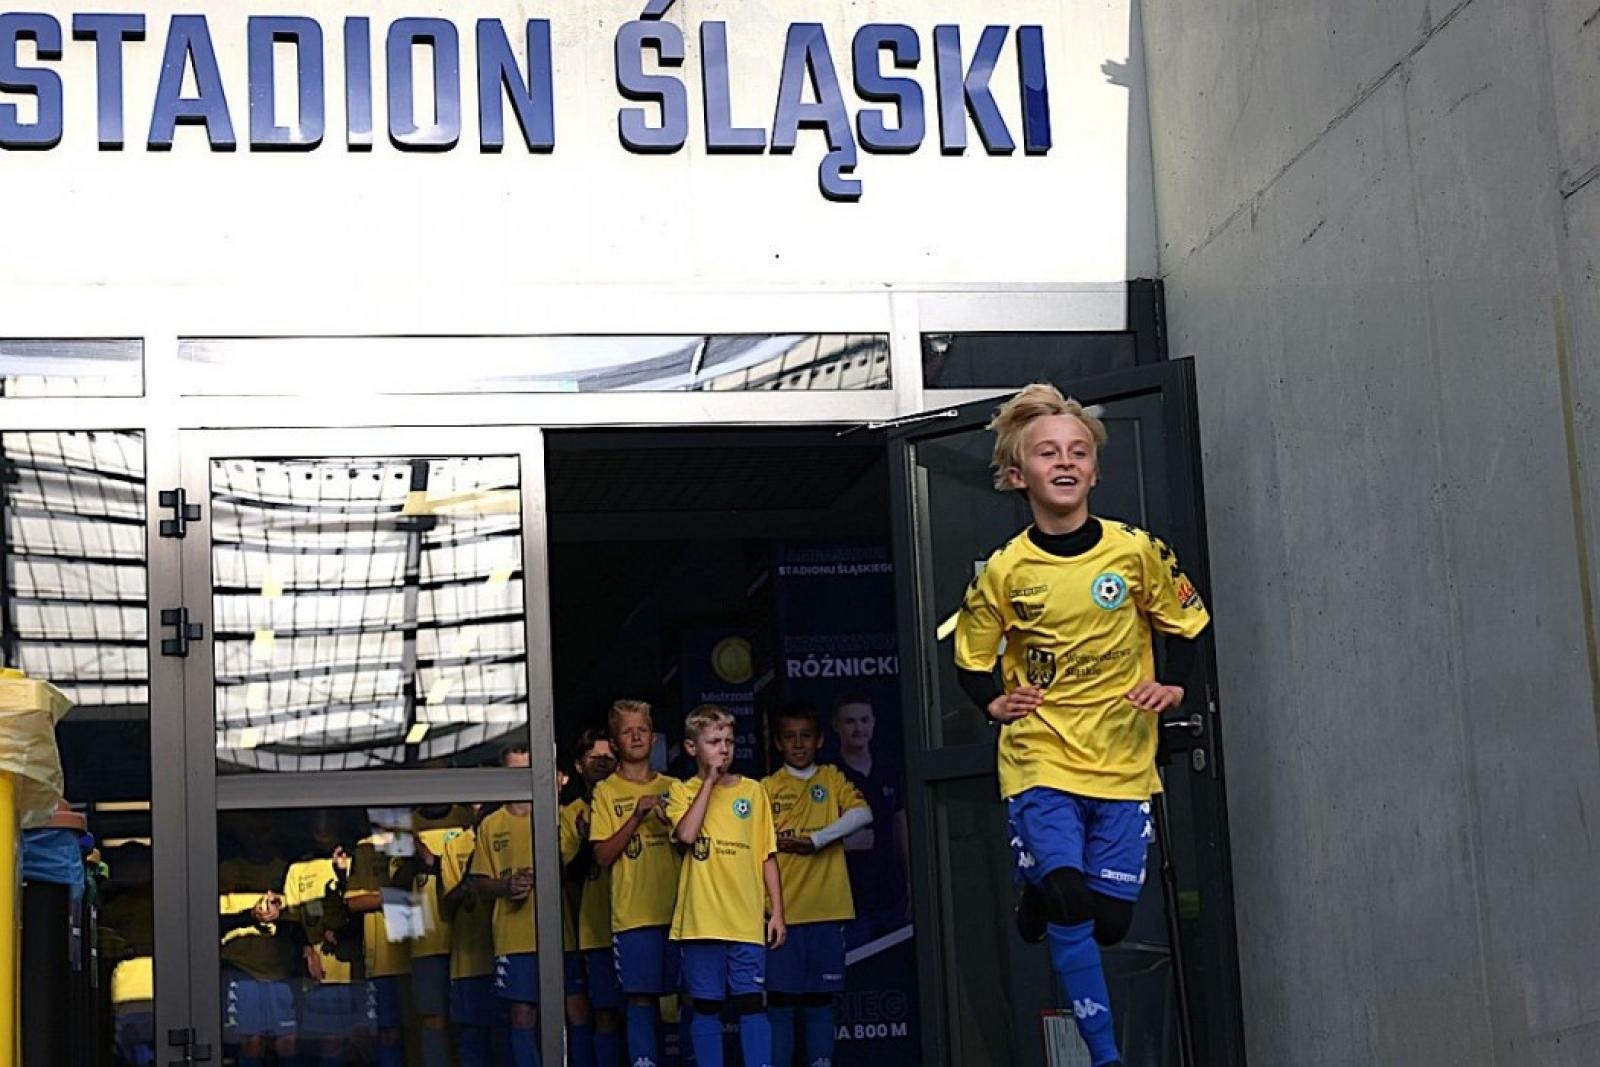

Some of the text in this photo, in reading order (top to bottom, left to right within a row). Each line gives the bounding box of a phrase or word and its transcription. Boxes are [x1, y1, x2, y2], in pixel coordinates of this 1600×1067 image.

[0, 0, 1052, 203] STADION ŚLĄSKI
[778, 565, 836, 576] STADIONU
[854, 1023, 888, 1039] 800
[890, 1021, 908, 1038] M
